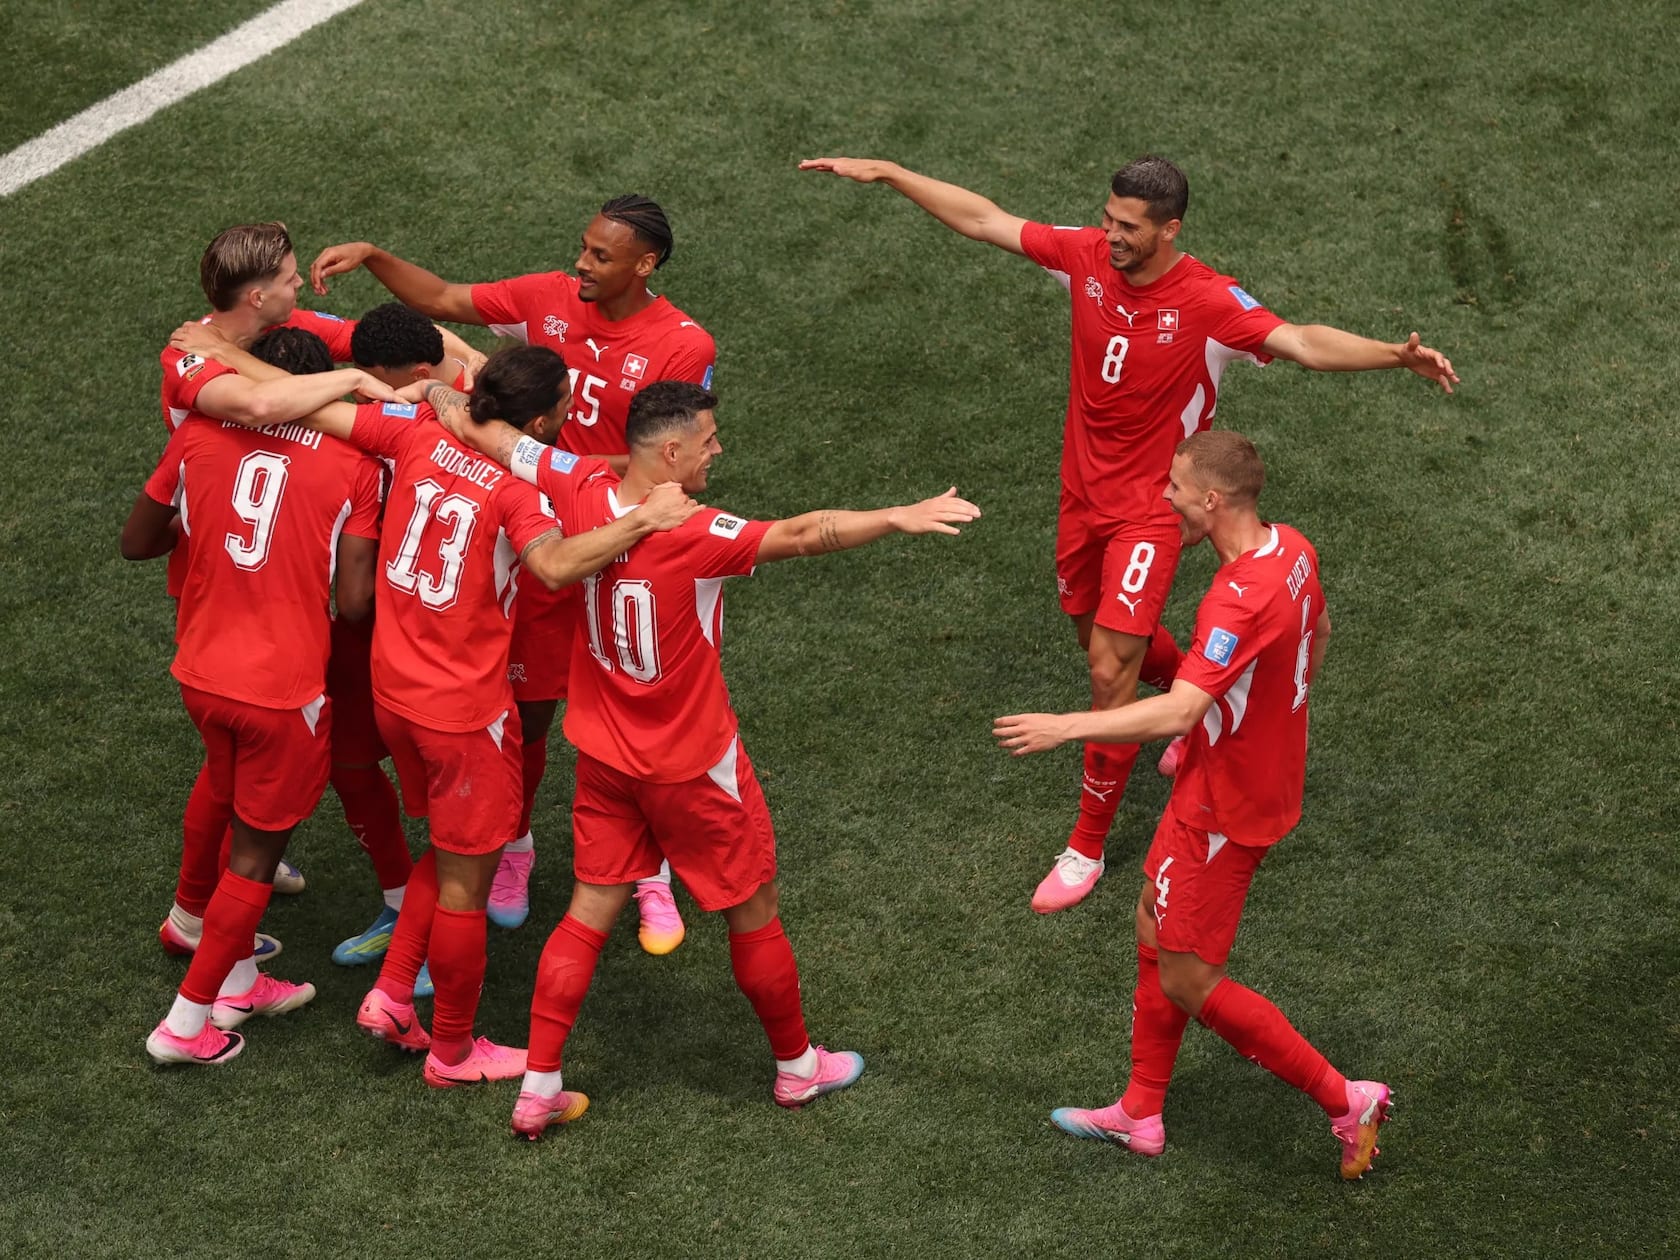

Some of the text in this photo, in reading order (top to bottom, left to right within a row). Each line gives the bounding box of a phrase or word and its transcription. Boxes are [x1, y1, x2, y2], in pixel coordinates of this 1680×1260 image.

[1101, 335, 1129, 384] 8
[221, 420, 324, 450] ZAMBI
[429, 438, 504, 491] RODIGUEZ
[224, 449, 291, 572] 9
[386, 477, 482, 612] 13
[1121, 541, 1156, 594] 8
[582, 570, 663, 687] 10
[1155, 856, 1175, 908] 4
